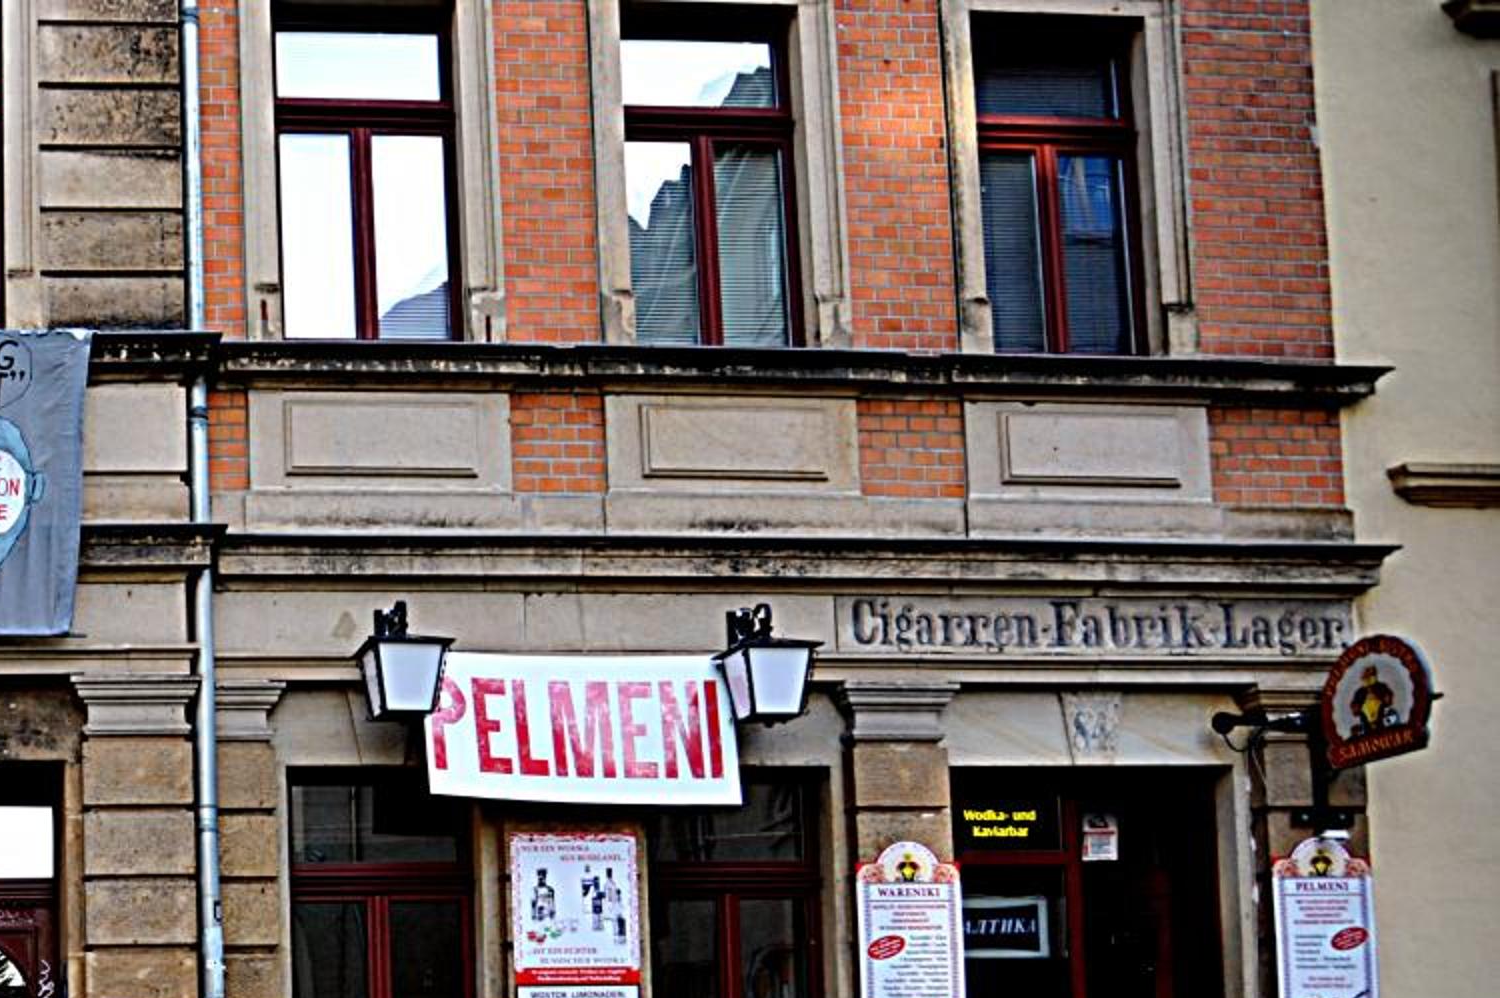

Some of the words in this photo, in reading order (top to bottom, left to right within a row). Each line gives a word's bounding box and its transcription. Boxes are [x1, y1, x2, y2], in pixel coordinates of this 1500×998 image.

[430, 676, 725, 779] PELMENI
[1013, 809, 1037, 821] und
[972, 825, 1029, 837] Kaviarbar
[878, 887, 941, 898] WARENIKI
[1295, 881, 1349, 892] PELMENI
